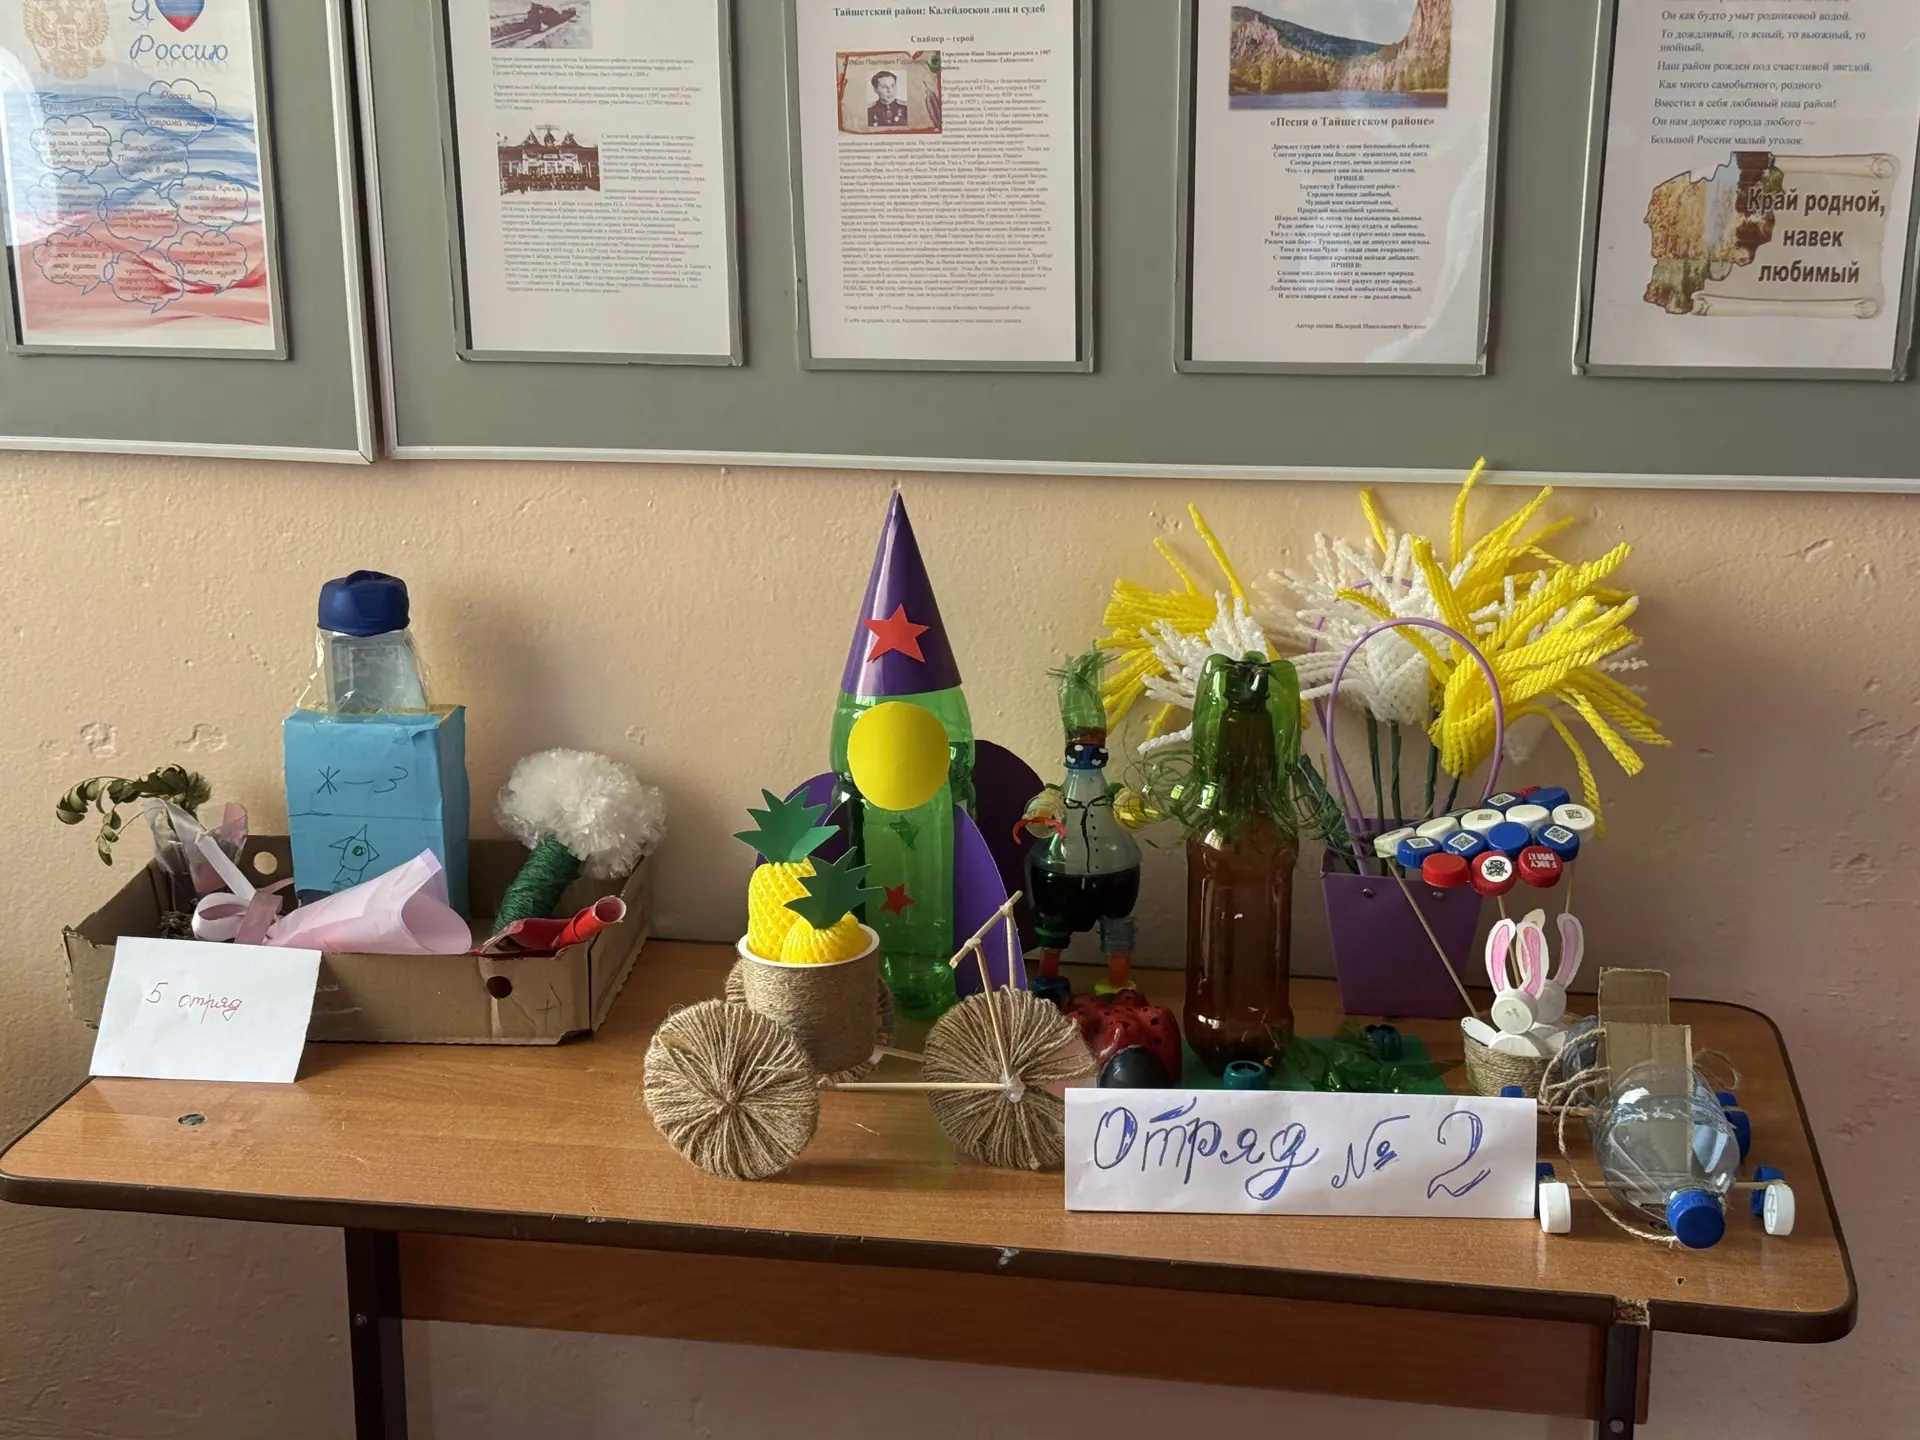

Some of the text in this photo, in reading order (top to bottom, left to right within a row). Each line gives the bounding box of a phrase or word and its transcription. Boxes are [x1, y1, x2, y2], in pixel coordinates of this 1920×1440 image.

[833, 4, 1046, 18] Тайшетский район: Калейдоскоп лиц и судеб
[1661, 10, 1677, 20] Он
[1697, 10, 1727, 22] будто
[1728, 12, 1755, 22] умыт
[1756, 12, 1816, 22] родниковой
[1819, 12, 1851, 21] водой.
[910, 35, 944, 44] Снайпер
[952, 34, 975, 44] герой
[1660, 29, 1674, 39] То
[1739, 31, 1749, 39] то
[1751, 30, 1784, 40] ясный,
[1788, 31, 1799, 39] то
[1800, 30, 1852, 41] вьюжный,
[1854, 31, 1866, 40] то
[130, 34, 229, 61] Россию
[1657, 60, 1679, 70] Наш
[1682, 61, 1711, 72] район
[1712, 63, 1750, 72] рожден
[1752, 63, 1771, 71] под
[1772, 62, 1830, 71] счастливой
[1659, 79, 1822, 92] Как много самобытного, родного
[1654, 98, 1696, 108] Вместил
[1706, 98, 1728, 108] себя
[1729, 98, 1779, 109] любимый
[1780, 100, 1801, 108] наш
[1803, 99, 1837, 110] район!
[1270, 116, 1436, 129] «Песня о Тайшетском районе»
[1652, 116, 1667, 126] Он
[1690, 119, 1727, 128] дороже
[1729, 119, 1762, 128] города
[1763, 117, 1801, 127] любого
[1650, 134, 1805, 147] Большой России малый уголок.
[1748, 188, 1886, 217] Край родной,
[1783, 229, 1845, 247] навек
[1758, 260, 1860, 283] любимый
[146, 982, 244, 1024] 5 отряд
[1094, 1096, 1491, 1201] Отряд № 2
